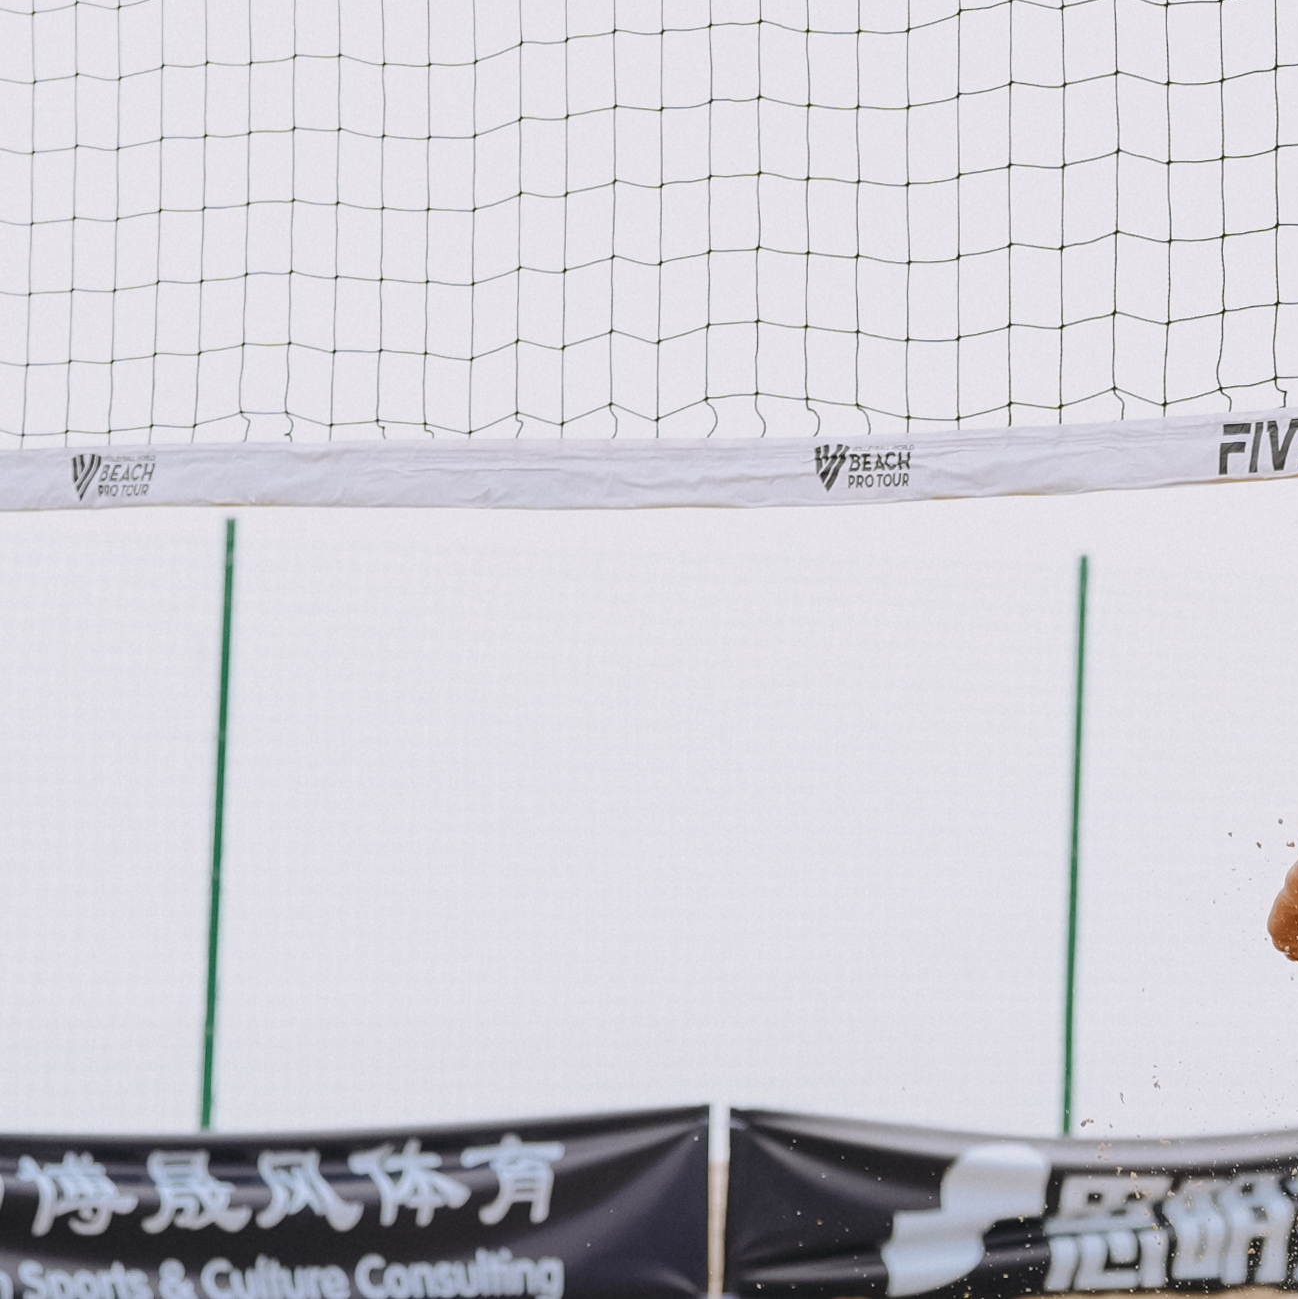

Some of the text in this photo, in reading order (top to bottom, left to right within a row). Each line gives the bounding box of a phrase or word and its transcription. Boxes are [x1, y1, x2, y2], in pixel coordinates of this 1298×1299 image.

[849, 451, 911, 472] BEACH
[99, 463, 156, 482] BEACH
[848, 472, 910, 489] PRO TOUR
[121, 483, 150, 497] TOUR
